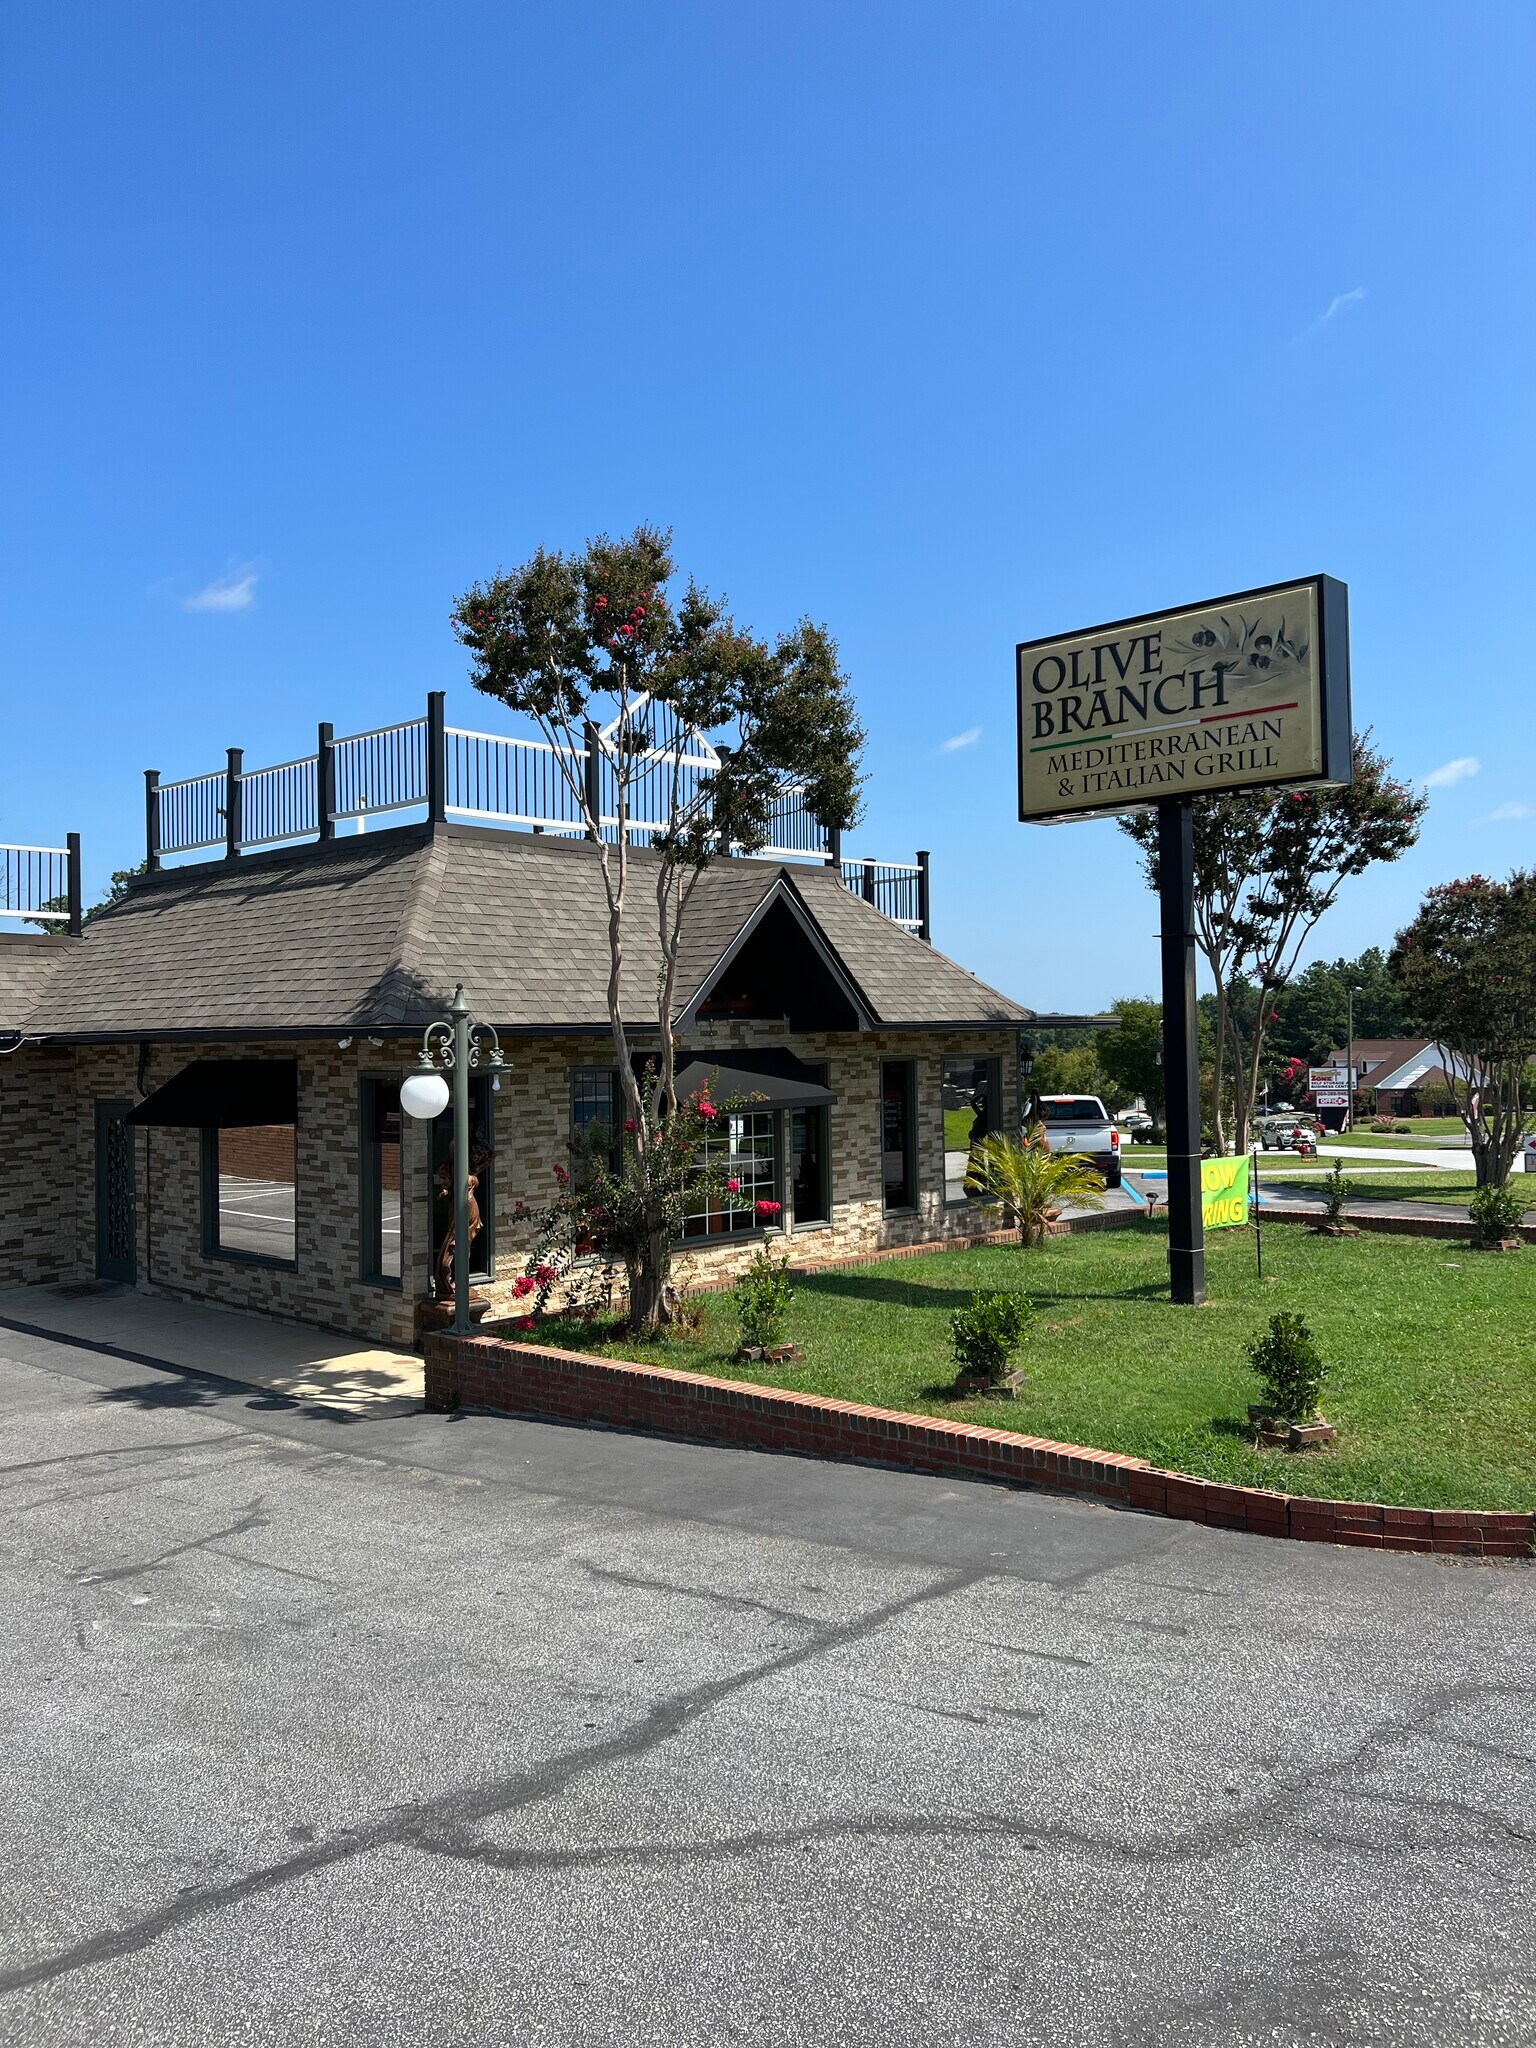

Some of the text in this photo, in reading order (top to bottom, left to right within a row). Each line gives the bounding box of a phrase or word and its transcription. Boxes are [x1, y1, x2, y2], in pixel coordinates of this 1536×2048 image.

[1032, 630, 1163, 694] OLIVE
[1031, 667, 1229, 740] BRANCH
[1046, 718, 1283, 776] MEDITERRANEAN
[1058, 746, 1279, 796] & ITALIAN GRILL
